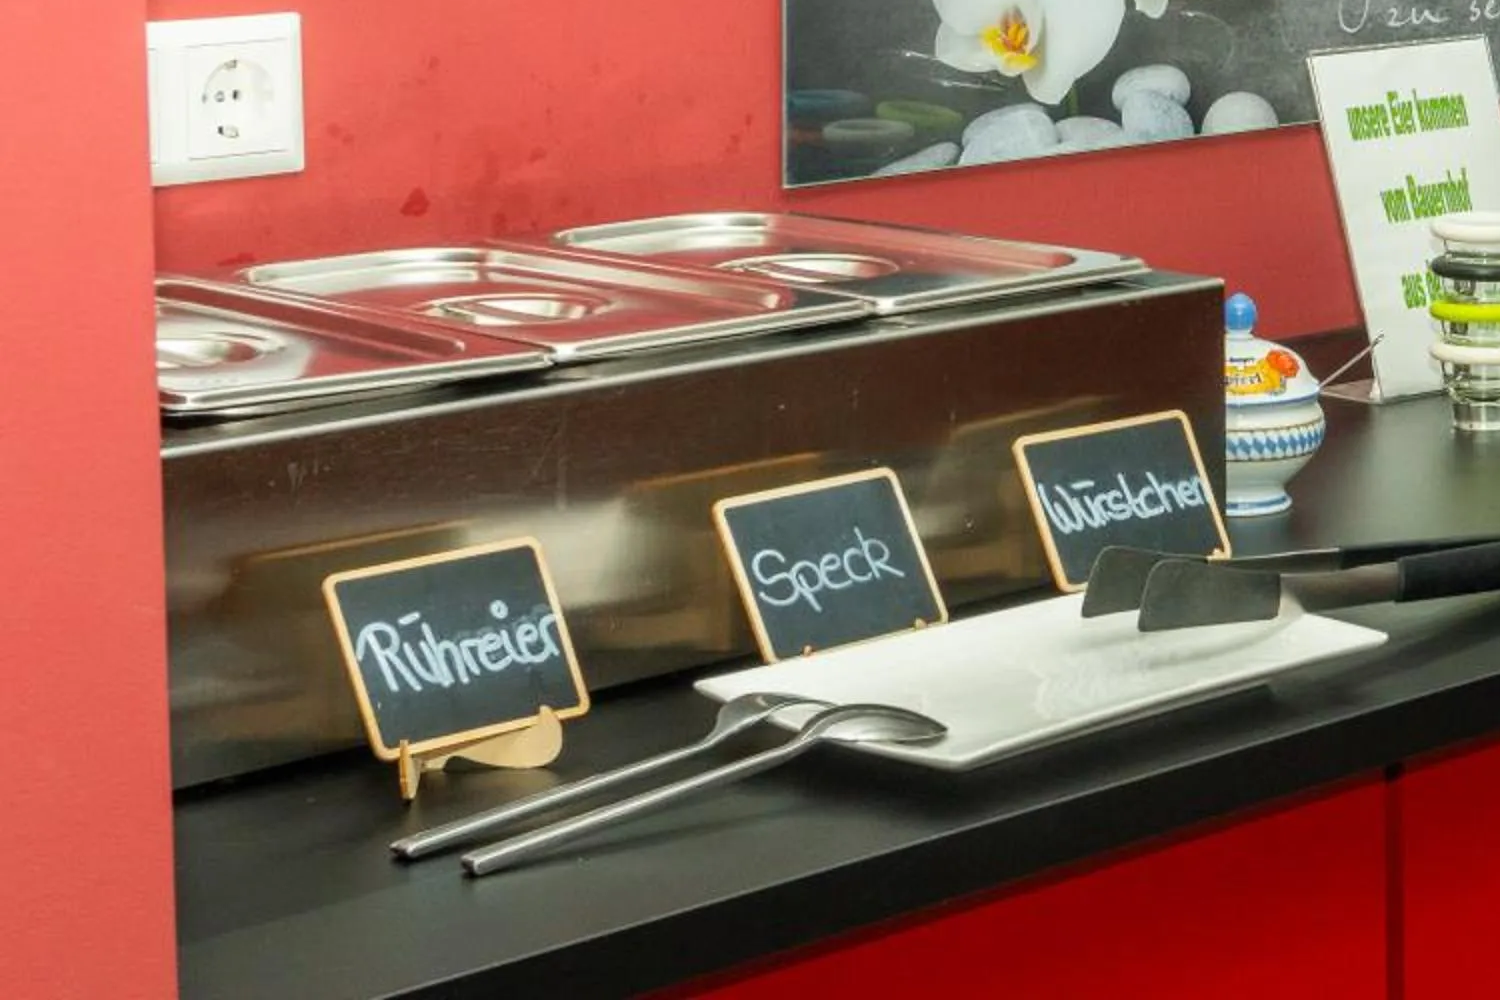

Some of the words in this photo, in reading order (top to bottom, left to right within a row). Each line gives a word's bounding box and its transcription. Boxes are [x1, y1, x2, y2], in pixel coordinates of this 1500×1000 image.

[1388, 6, 1449, 27] zu
[751, 526, 906, 613] Speck
[356, 600, 560, 692] Rühreier
